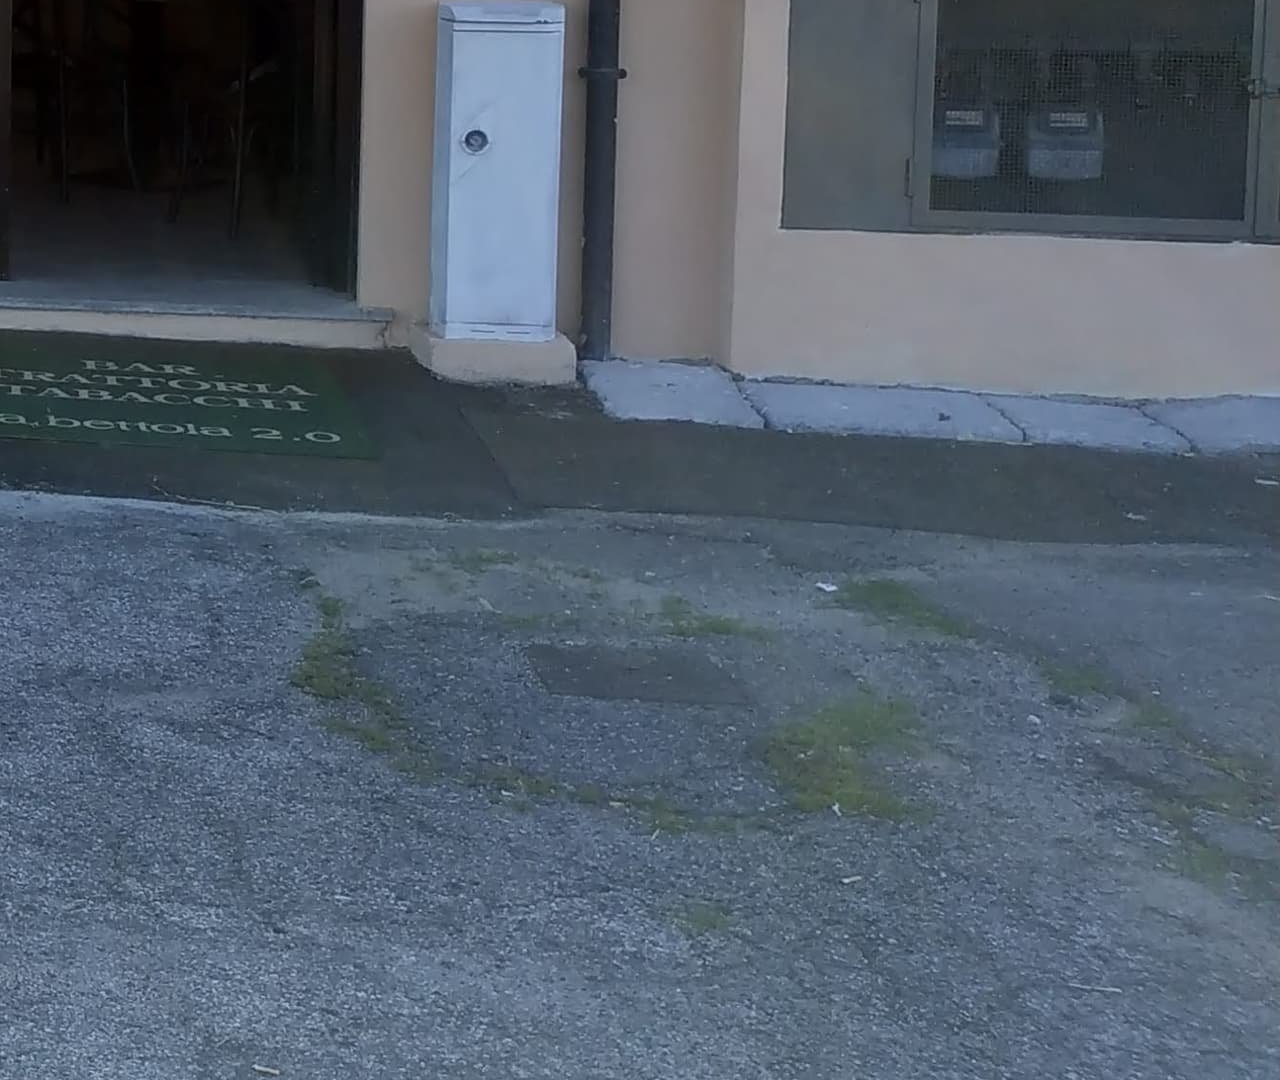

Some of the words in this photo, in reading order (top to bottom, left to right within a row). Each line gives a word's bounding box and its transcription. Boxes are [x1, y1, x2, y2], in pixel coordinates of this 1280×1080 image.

[80, 360, 201, 376] BAR
[45, 409, 232, 437] bettola
[251, 427, 341, 443] 2.0
